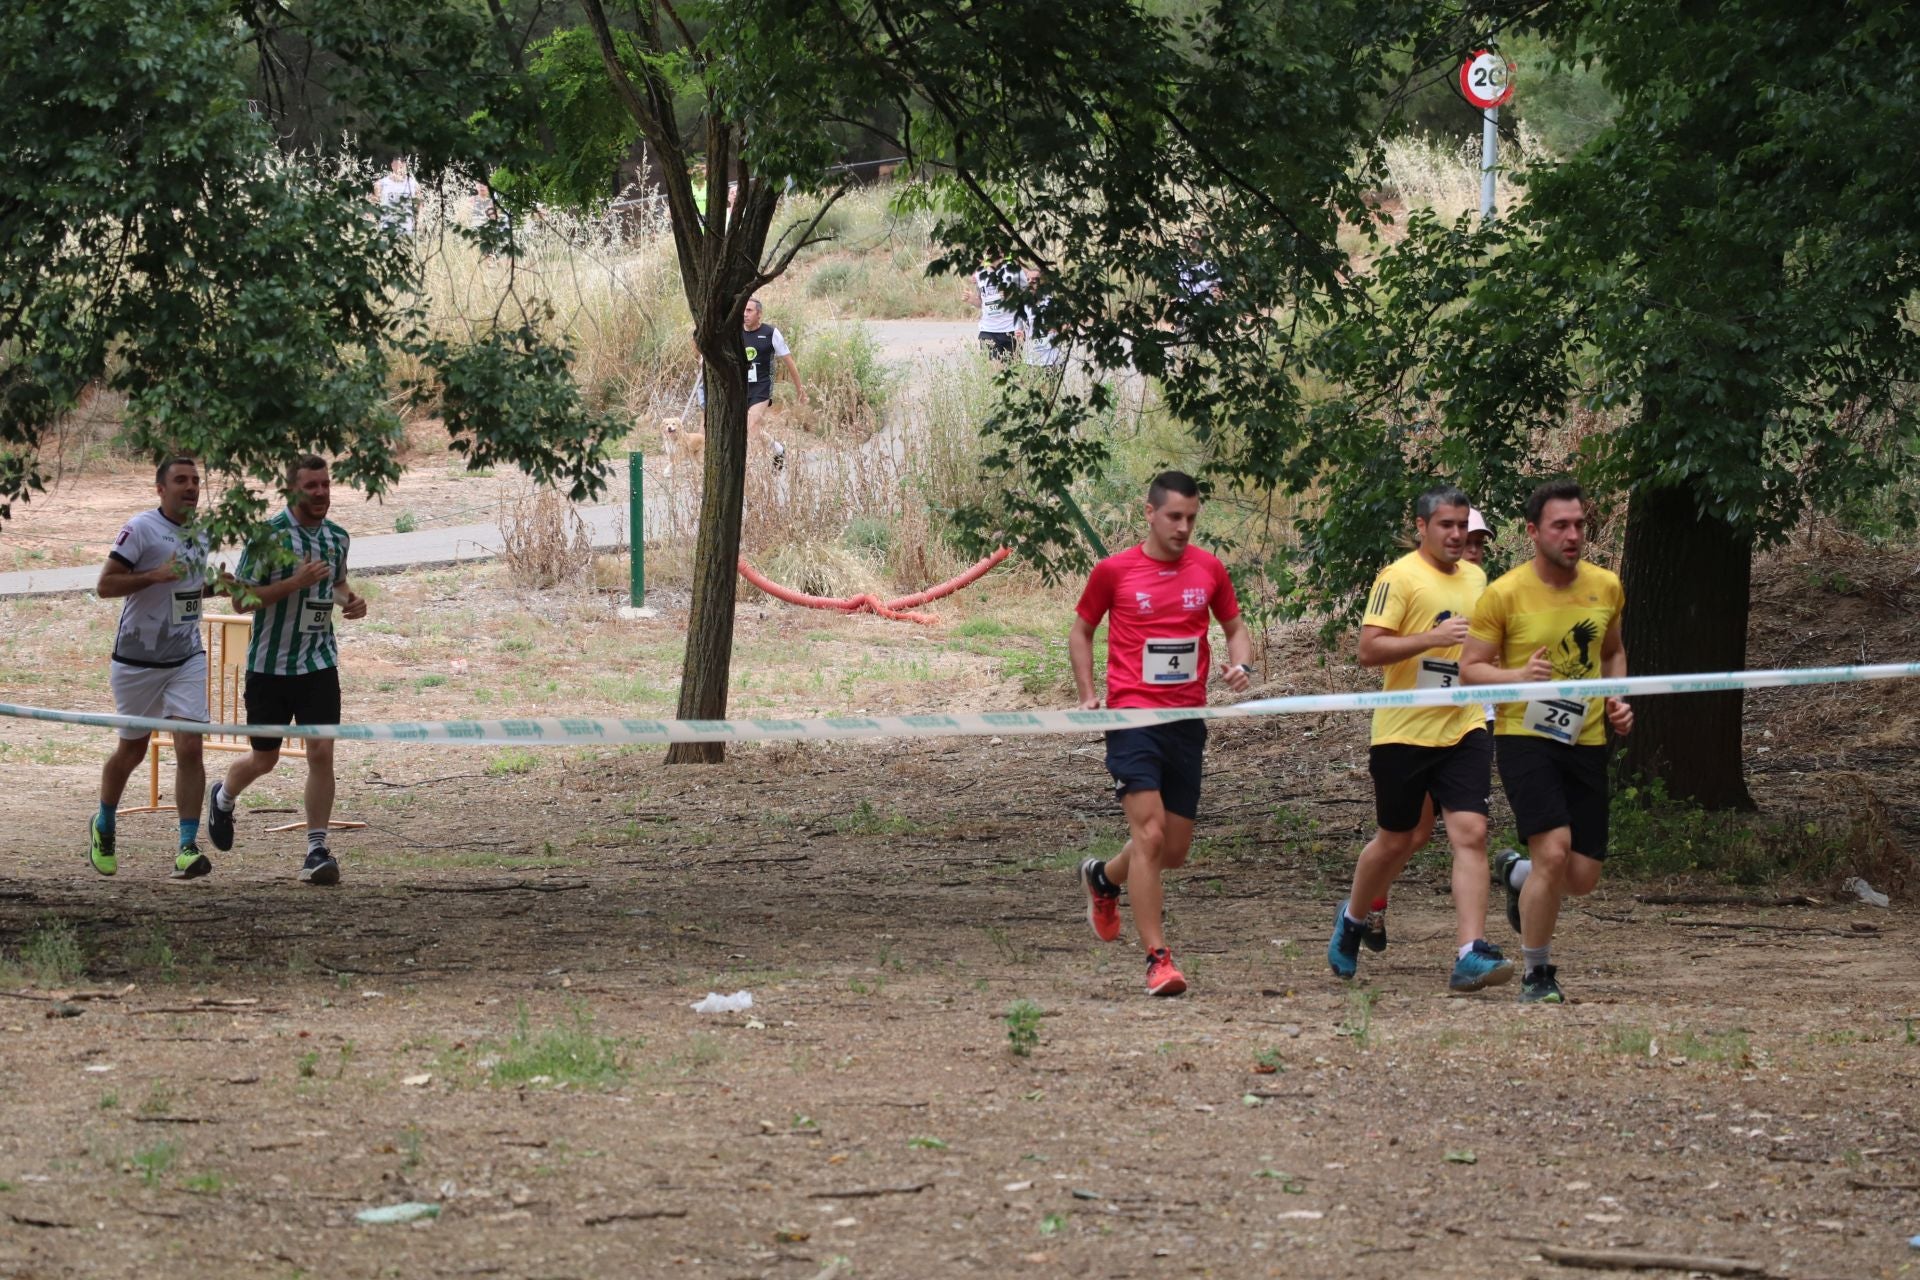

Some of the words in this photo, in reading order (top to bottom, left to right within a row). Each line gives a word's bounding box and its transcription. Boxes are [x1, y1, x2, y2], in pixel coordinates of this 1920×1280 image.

[185, 600, 198, 612] 80
[313, 611, 328, 623] 87
[1168, 655, 1180, 669] 4
[1440, 674, 1452, 688] 3
[1543, 707, 1570, 727] 26
